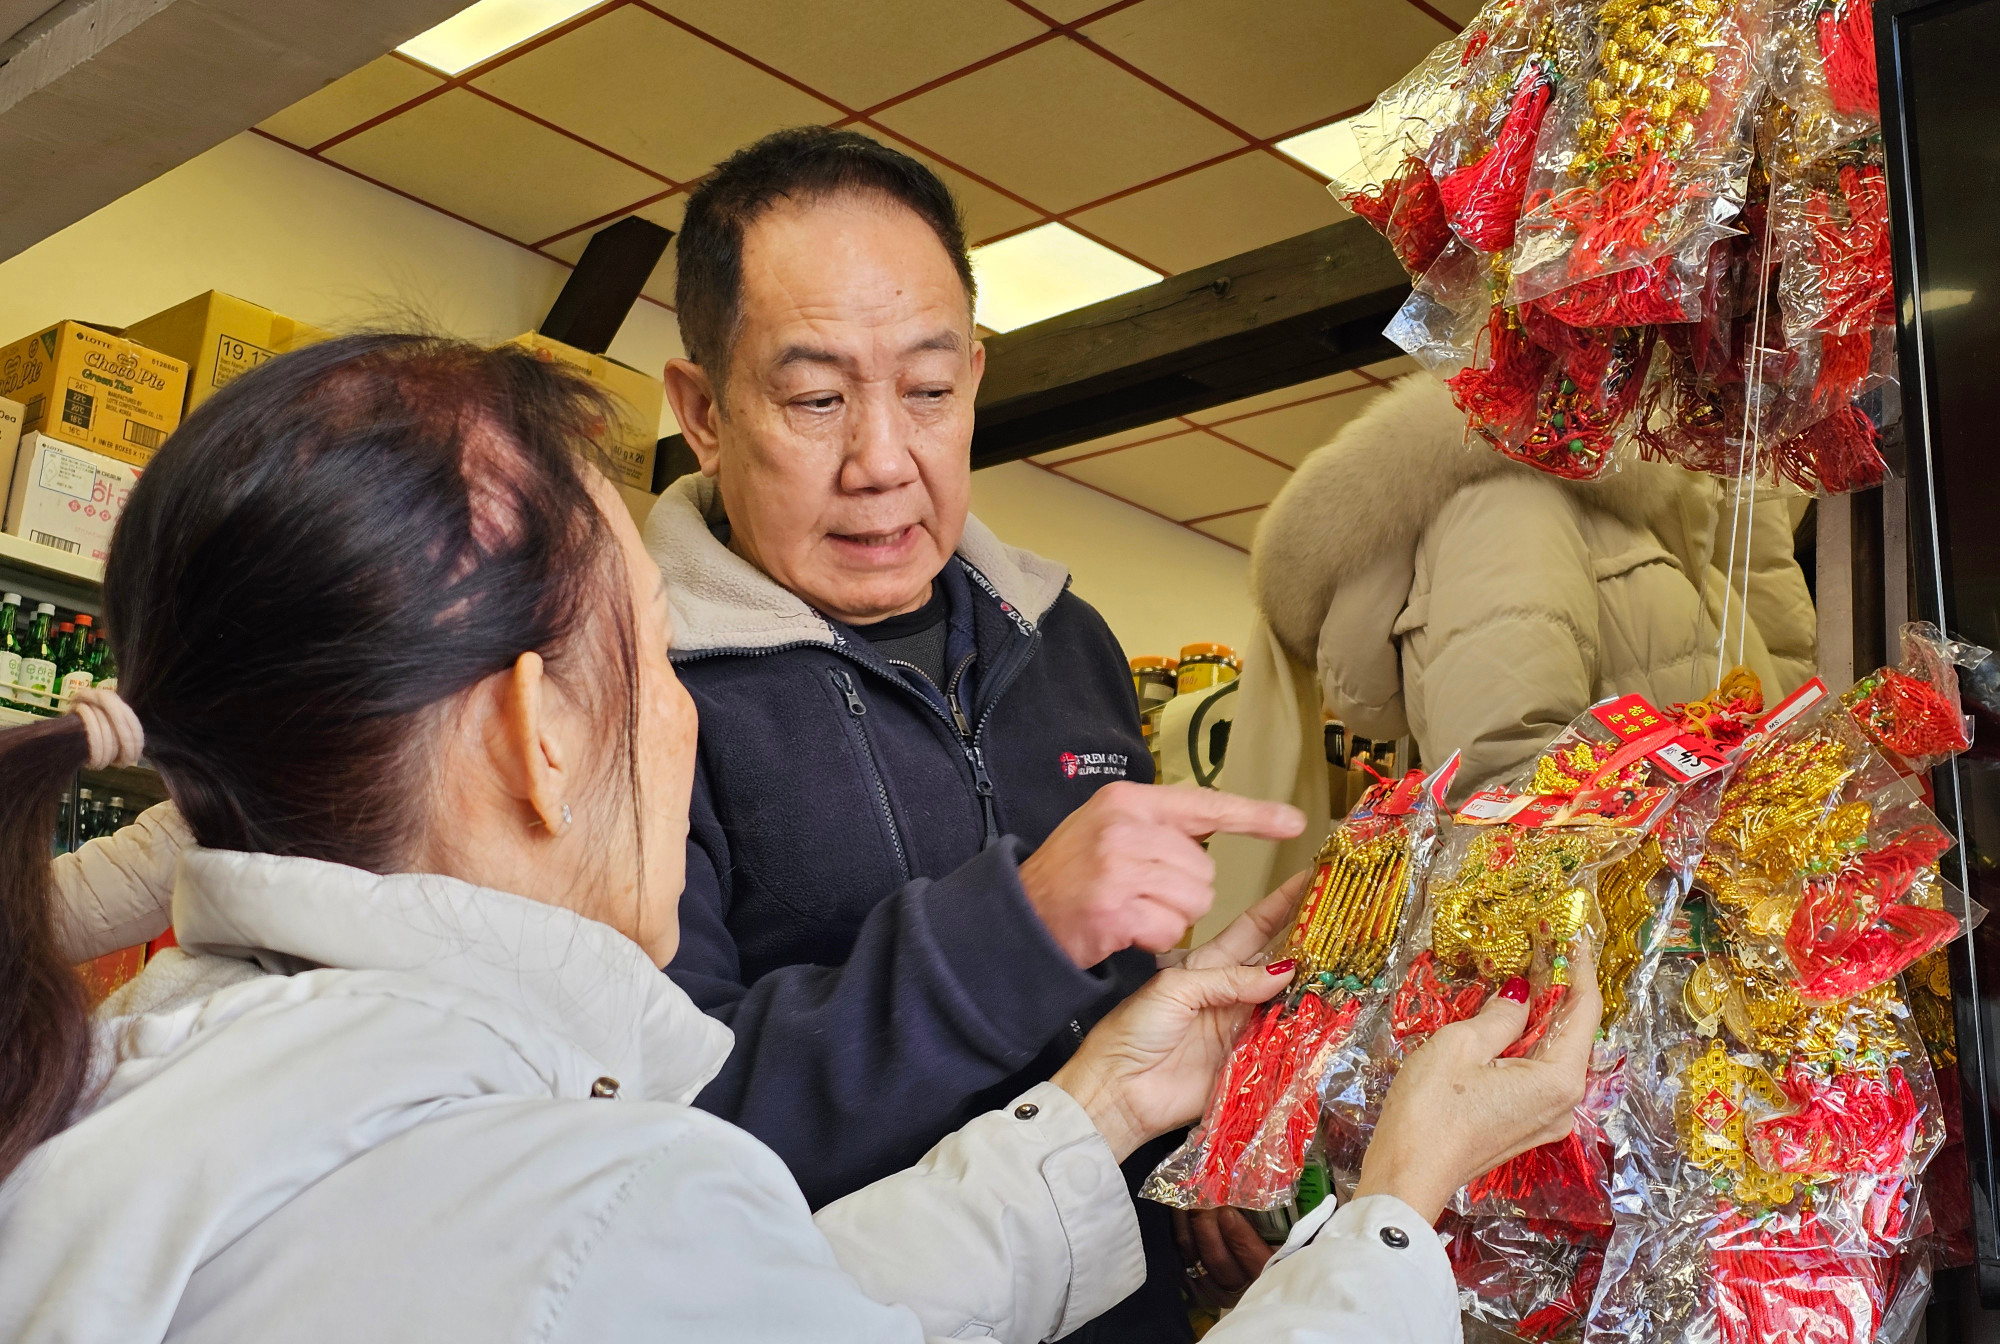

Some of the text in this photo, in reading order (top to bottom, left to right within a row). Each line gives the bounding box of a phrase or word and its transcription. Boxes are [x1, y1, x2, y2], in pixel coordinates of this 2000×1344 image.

[85, 335, 112, 349] LOTTE
[84, 350, 136, 381] Choco
[135, 367, 166, 391] Pie
[82, 368, 134, 395] Green Tea
[635, 453, 645, 465] 20
